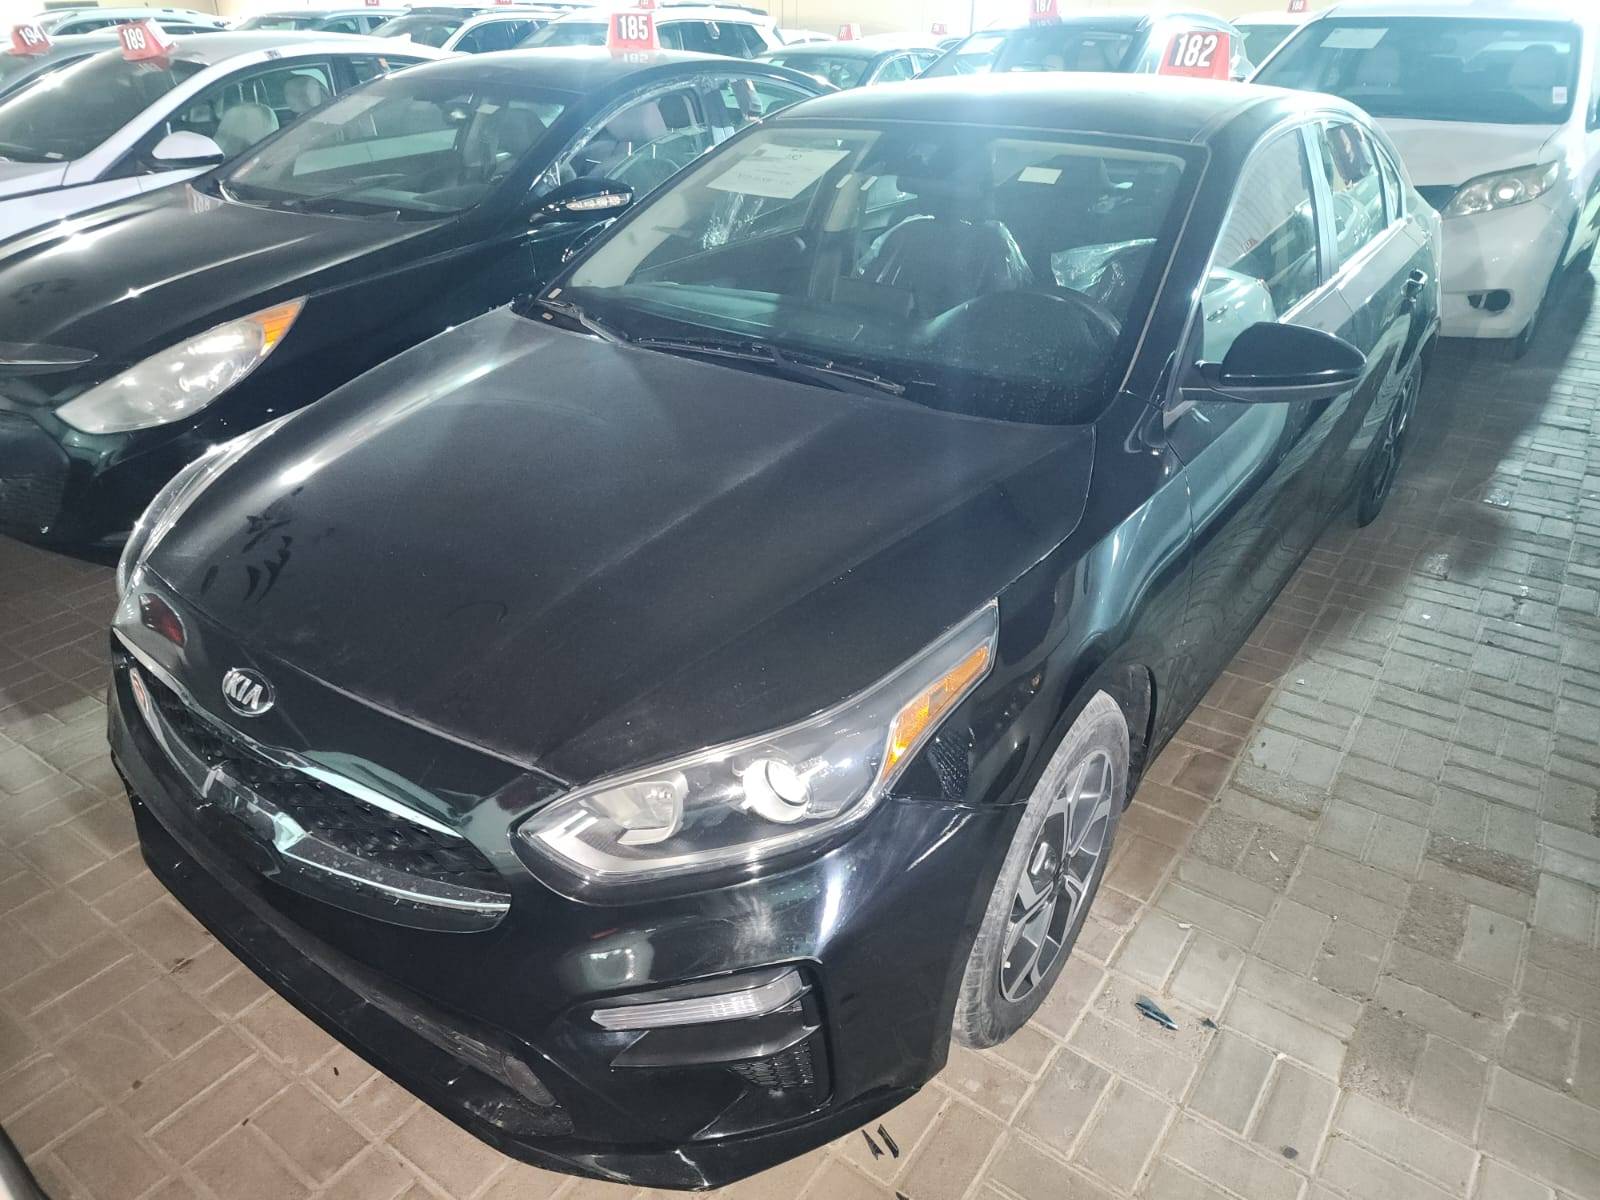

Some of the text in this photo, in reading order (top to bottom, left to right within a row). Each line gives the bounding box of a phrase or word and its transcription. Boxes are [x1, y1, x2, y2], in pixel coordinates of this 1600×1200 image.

[19, 25, 45, 47] 194
[122, 27, 146, 50] 189
[619, 15, 649, 40] 185
[1174, 33, 1218, 67] 182
[225, 671, 263, 710] KIA
